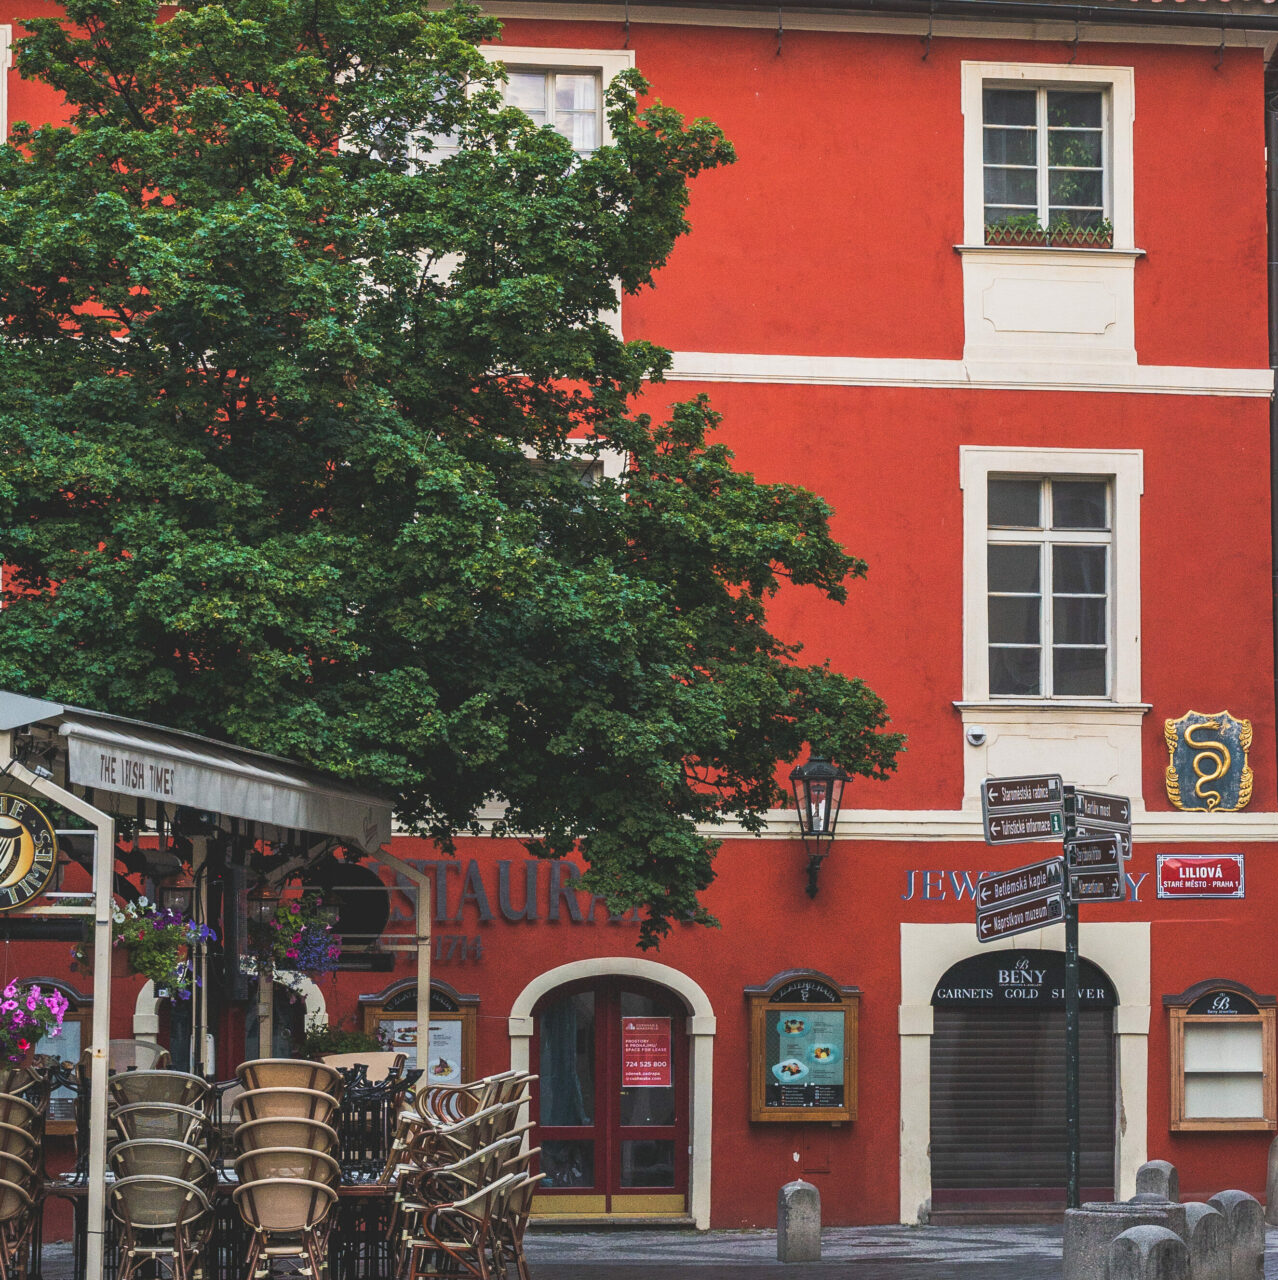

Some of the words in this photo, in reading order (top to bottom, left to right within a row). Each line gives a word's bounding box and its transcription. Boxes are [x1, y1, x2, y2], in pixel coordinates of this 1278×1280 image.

[101, 754, 117, 785] THE
[1026, 817, 1051, 834] informace
[8, 829, 53, 905] TIMES
[1179, 864, 1224, 879] LILIOVÁ
[994, 877, 1028, 899] Betlémská
[1028, 871, 1047, 890] kaple
[1163, 880, 1184, 888] STARÉ
[1185, 879, 1207, 888] MĚSTO
[1212, 880, 1234, 888] PRAHA
[1235, 880, 1239, 888] 1
[1024, 906, 1048, 923] muzeum
[434, 934, 484, 961] 1714
[998, 970, 1047, 984] BENY
[937, 988, 993, 999] GARNETS
[1004, 988, 1039, 999] GOLD
[1051, 988, 1105, 999] SIVER
